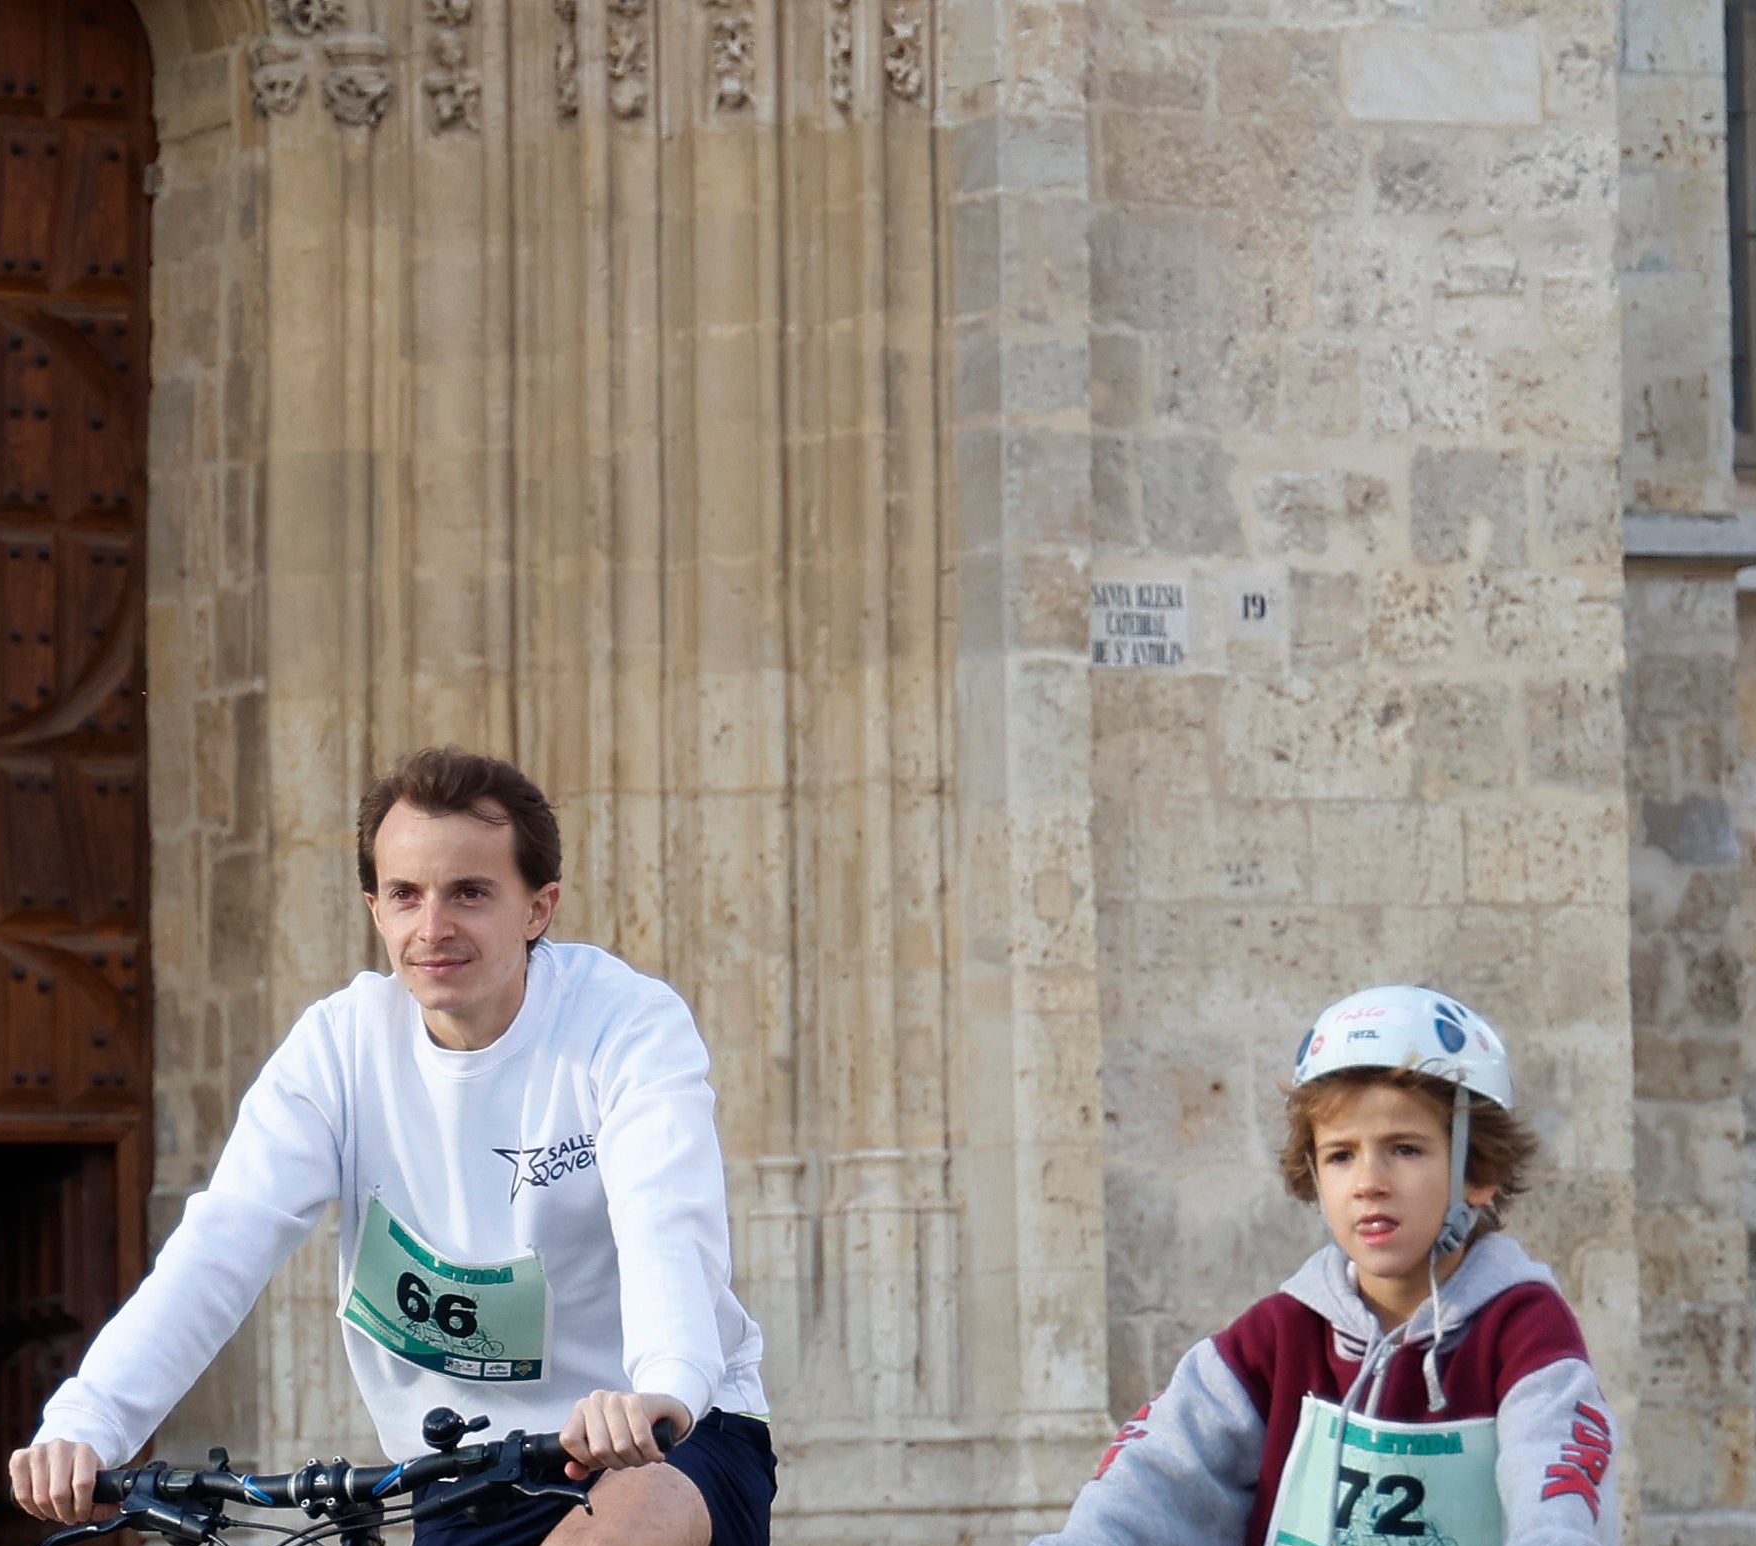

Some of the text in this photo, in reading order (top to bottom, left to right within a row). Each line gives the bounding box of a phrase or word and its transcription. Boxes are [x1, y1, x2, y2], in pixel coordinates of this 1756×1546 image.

[1242, 593, 1266, 619] 19
[548, 1134, 595, 1162] SALLE
[396, 1271, 478, 1338] 66
[1335, 1465, 1426, 1536] 72
